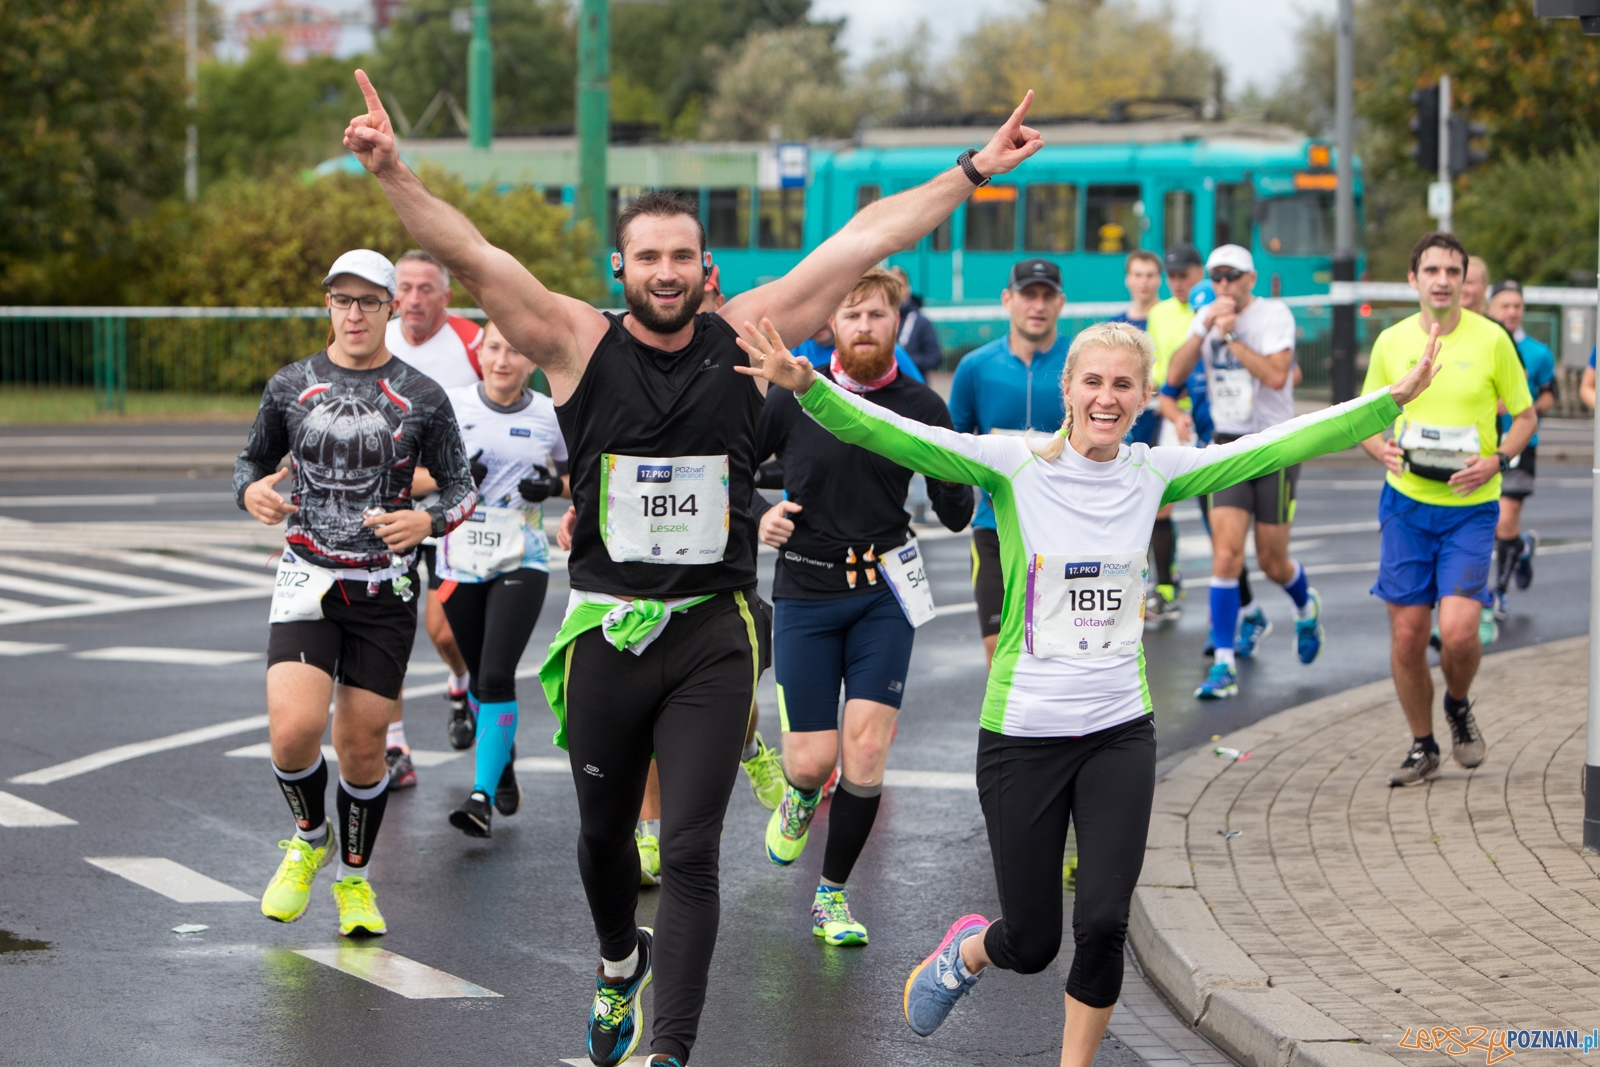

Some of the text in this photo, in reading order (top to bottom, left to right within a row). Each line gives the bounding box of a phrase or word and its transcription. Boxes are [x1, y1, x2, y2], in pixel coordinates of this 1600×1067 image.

[640, 469, 671, 479] 17.PKO
[641, 494, 698, 516] 1814
[650, 523, 689, 533] Leszek
[467, 530, 501, 547] 3151
[1068, 565, 1098, 575] 17.PKO
[277, 571, 310, 588] 2172
[1069, 589, 1122, 611] 1815
[1074, 617, 1115, 627] Oktawia
